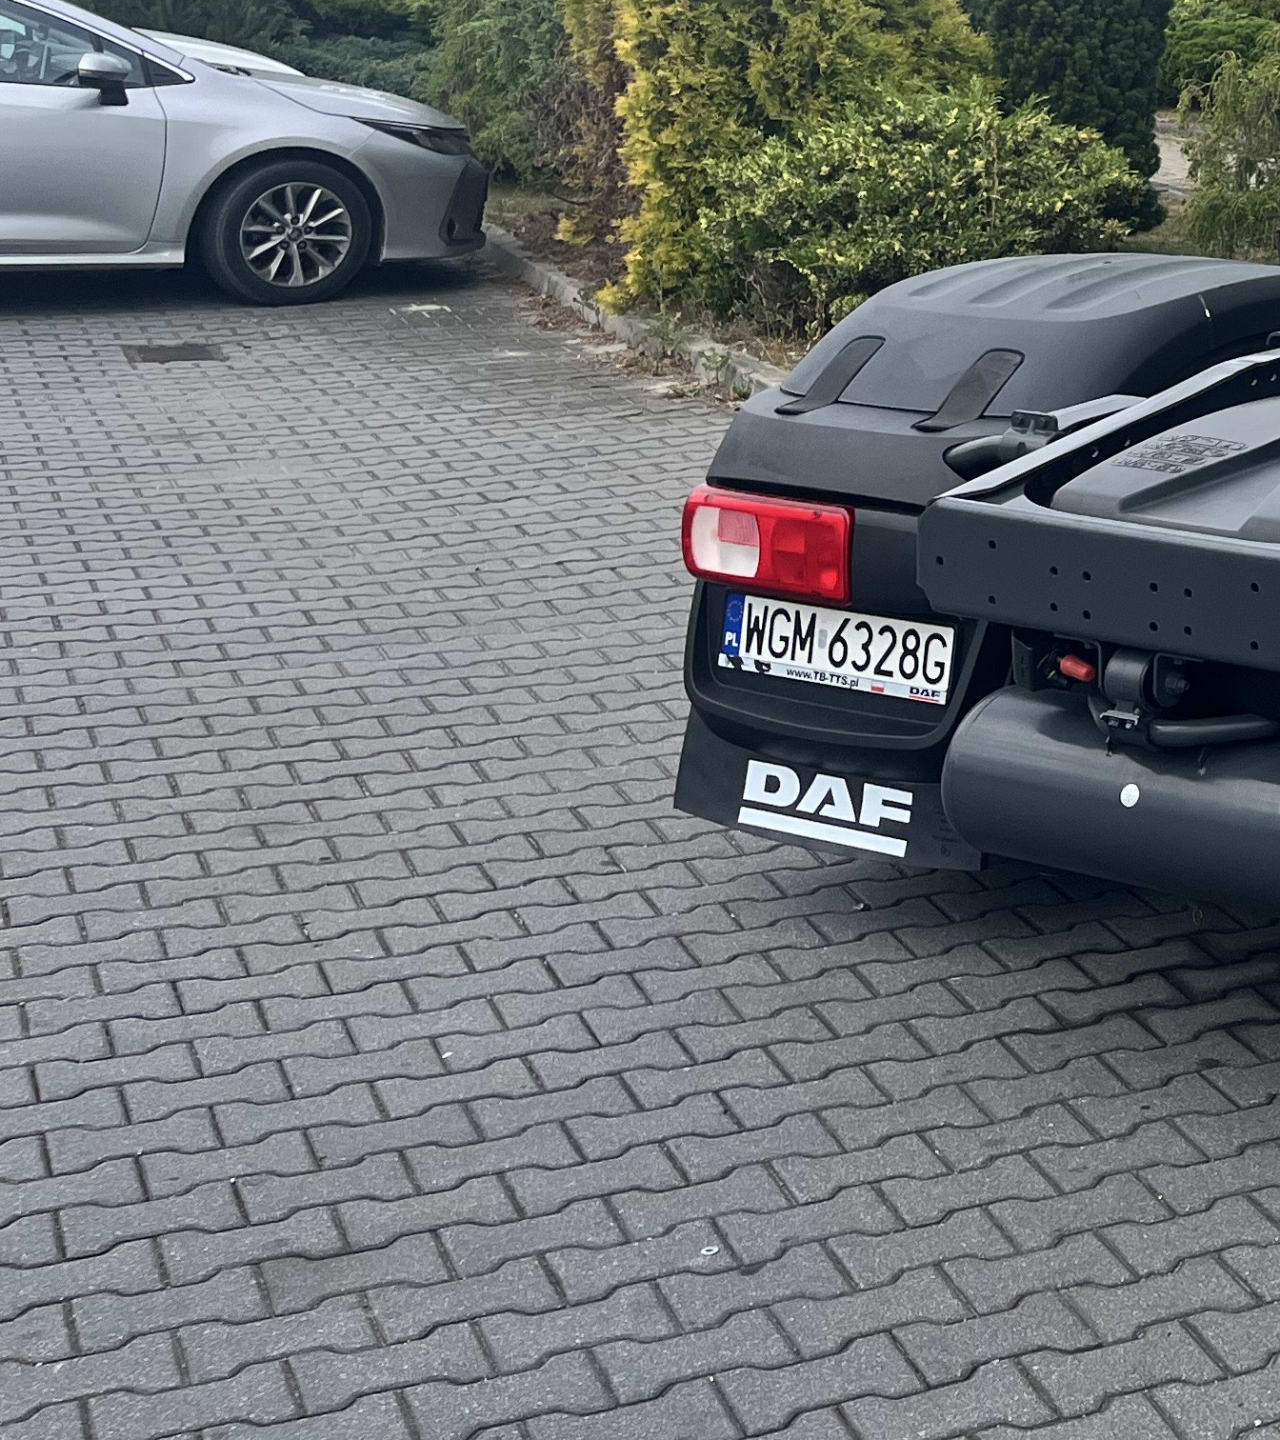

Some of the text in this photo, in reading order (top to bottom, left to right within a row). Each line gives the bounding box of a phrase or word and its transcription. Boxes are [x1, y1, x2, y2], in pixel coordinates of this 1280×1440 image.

[724, 631, 739, 648] PL
[745, 602, 949, 685] WGM 6328G
[786, 667, 860, 690] www.TB-TTS.pl
[909, 686, 941, 698] DAF
[742, 759, 914, 828] DAF
